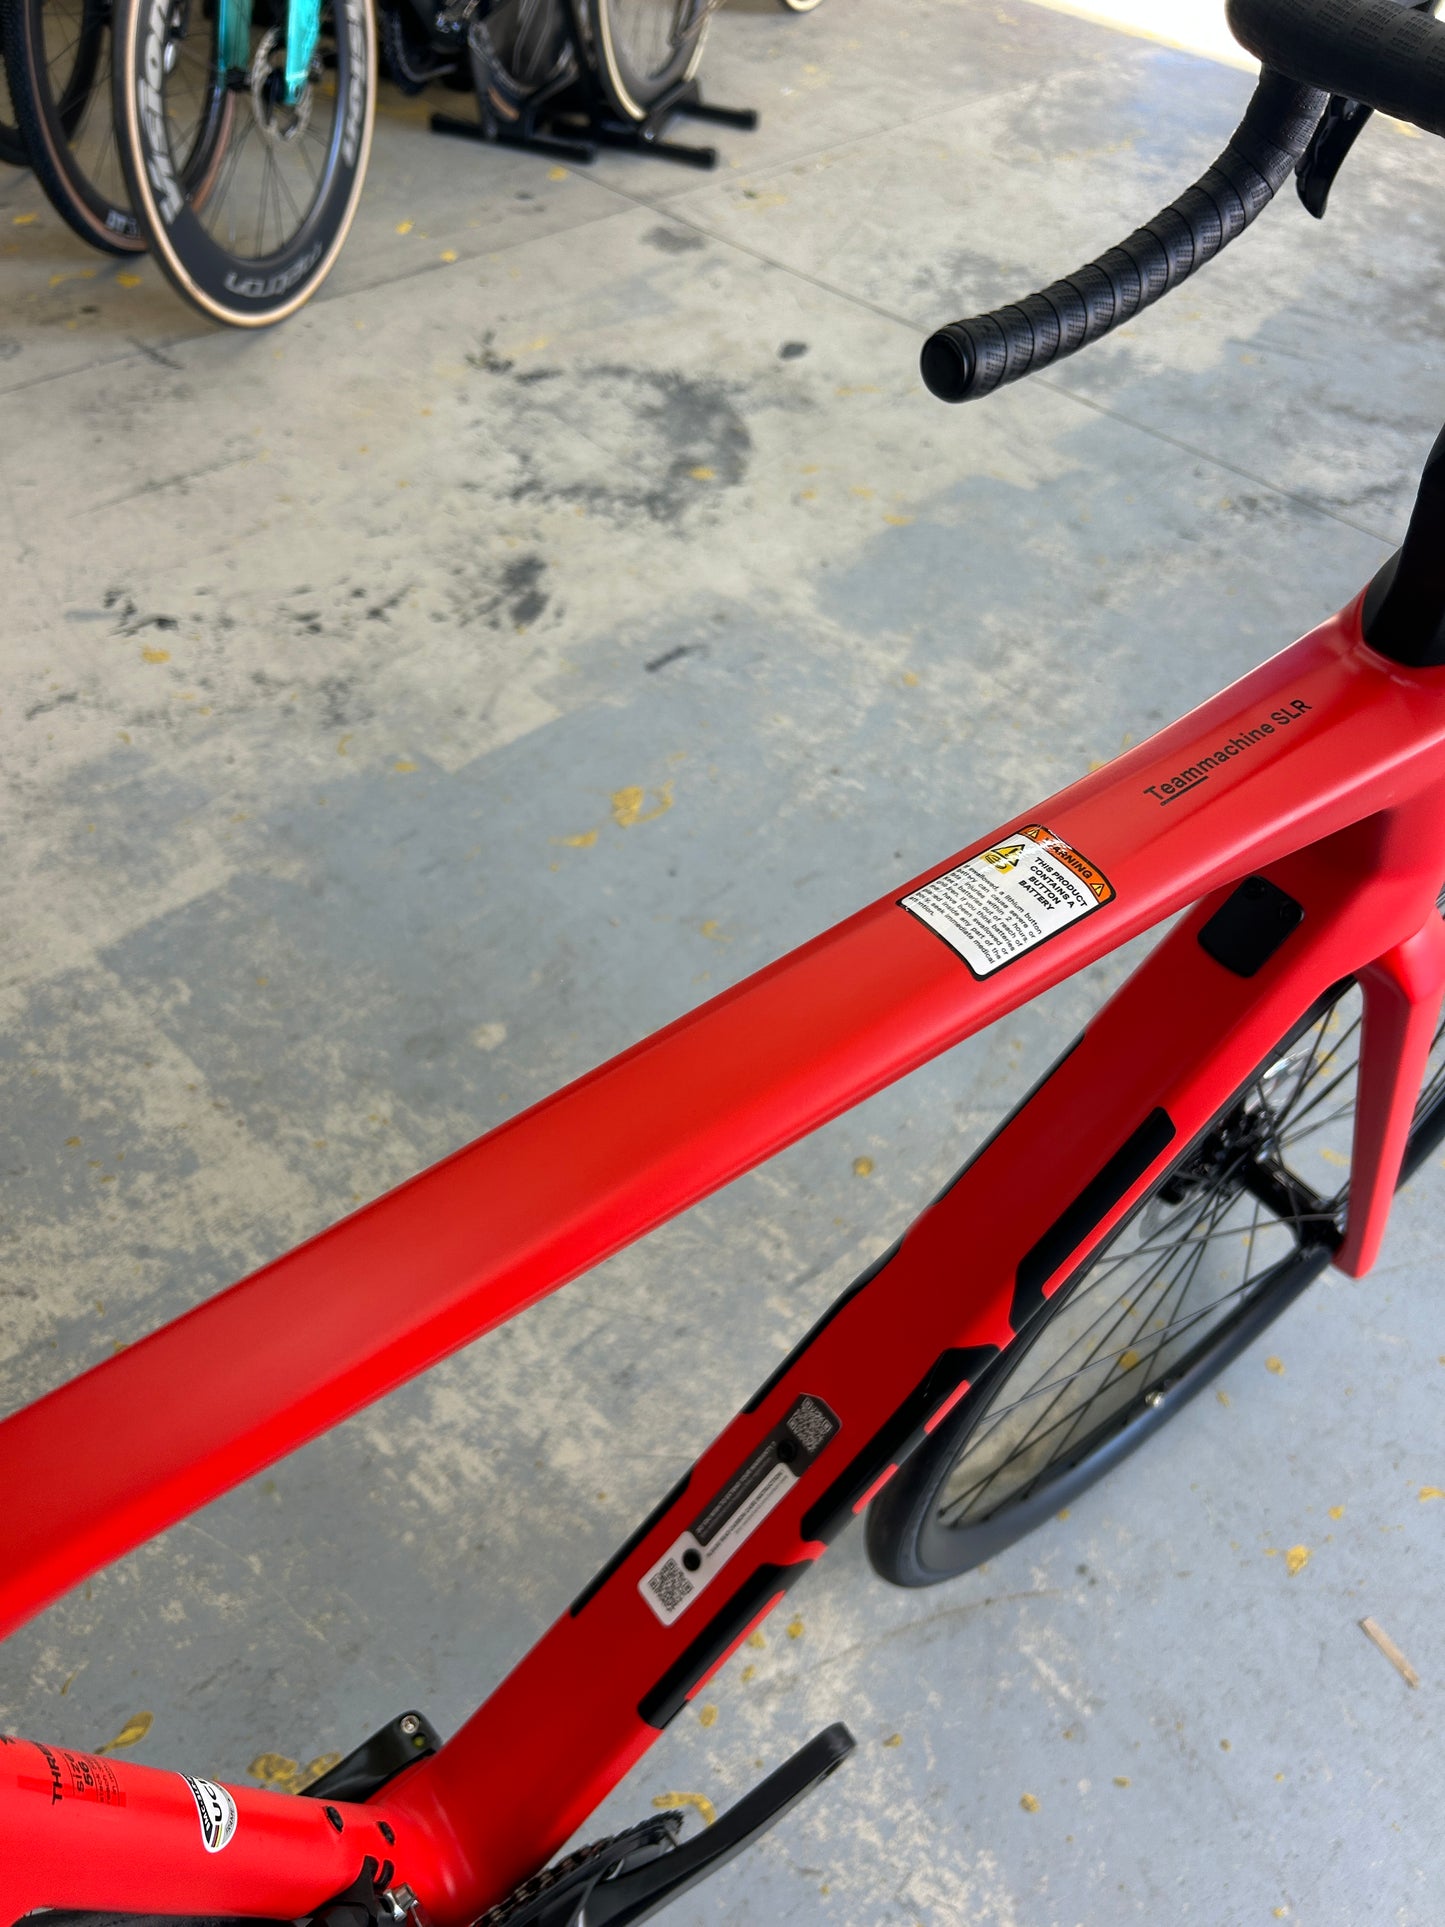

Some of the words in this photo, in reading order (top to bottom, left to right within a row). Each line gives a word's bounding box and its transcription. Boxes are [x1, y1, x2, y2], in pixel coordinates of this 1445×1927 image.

[1143, 722, 1276, 802] Teammachine
[1270, 699, 1313, 725] SLR
[1043, 837, 1093, 879] ARNING
[1018, 880, 1055, 911] BATTERY
[1028, 876, 1061, 905] BUTTON
[1030, 865, 1070, 900] CONTAINS
[1067, 900, 1075, 909] A
[1034, 857, 1054, 873] THIS
[1051, 871, 1088, 907] PRODUCT
[942, 901, 959, 916] inside
[960, 917, 971, 926] any
[970, 927, 985, 939] part
[992, 947, 1001, 960] the
[957, 904, 973, 918] been
[973, 918, 1003, 946] swallowed
[1001, 947, 1009, 955] or
[958, 885, 983, 907] batteries
[982, 906, 994, 915] out
[1000, 921, 1016, 938] reach
[1015, 939, 1023, 947] of
[964, 901, 977, 911] you
[976, 911, 992, 924] think
[991, 924, 1015, 951] batteries
[978, 884, 989, 893] can
[991, 894, 1008, 909] cause
[1009, 910, 1029, 929] severe
[1028, 930, 1036, 938] or
[986, 900, 1005, 915] within
[1004, 894, 1025, 913] lithium
[1024, 912, 1042, 935] button
[944, 914, 974, 940] immediate
[973, 939, 996, 964] medical
[78, 1761, 94, 1787] 56
[198, 1779, 223, 1821] UCI
